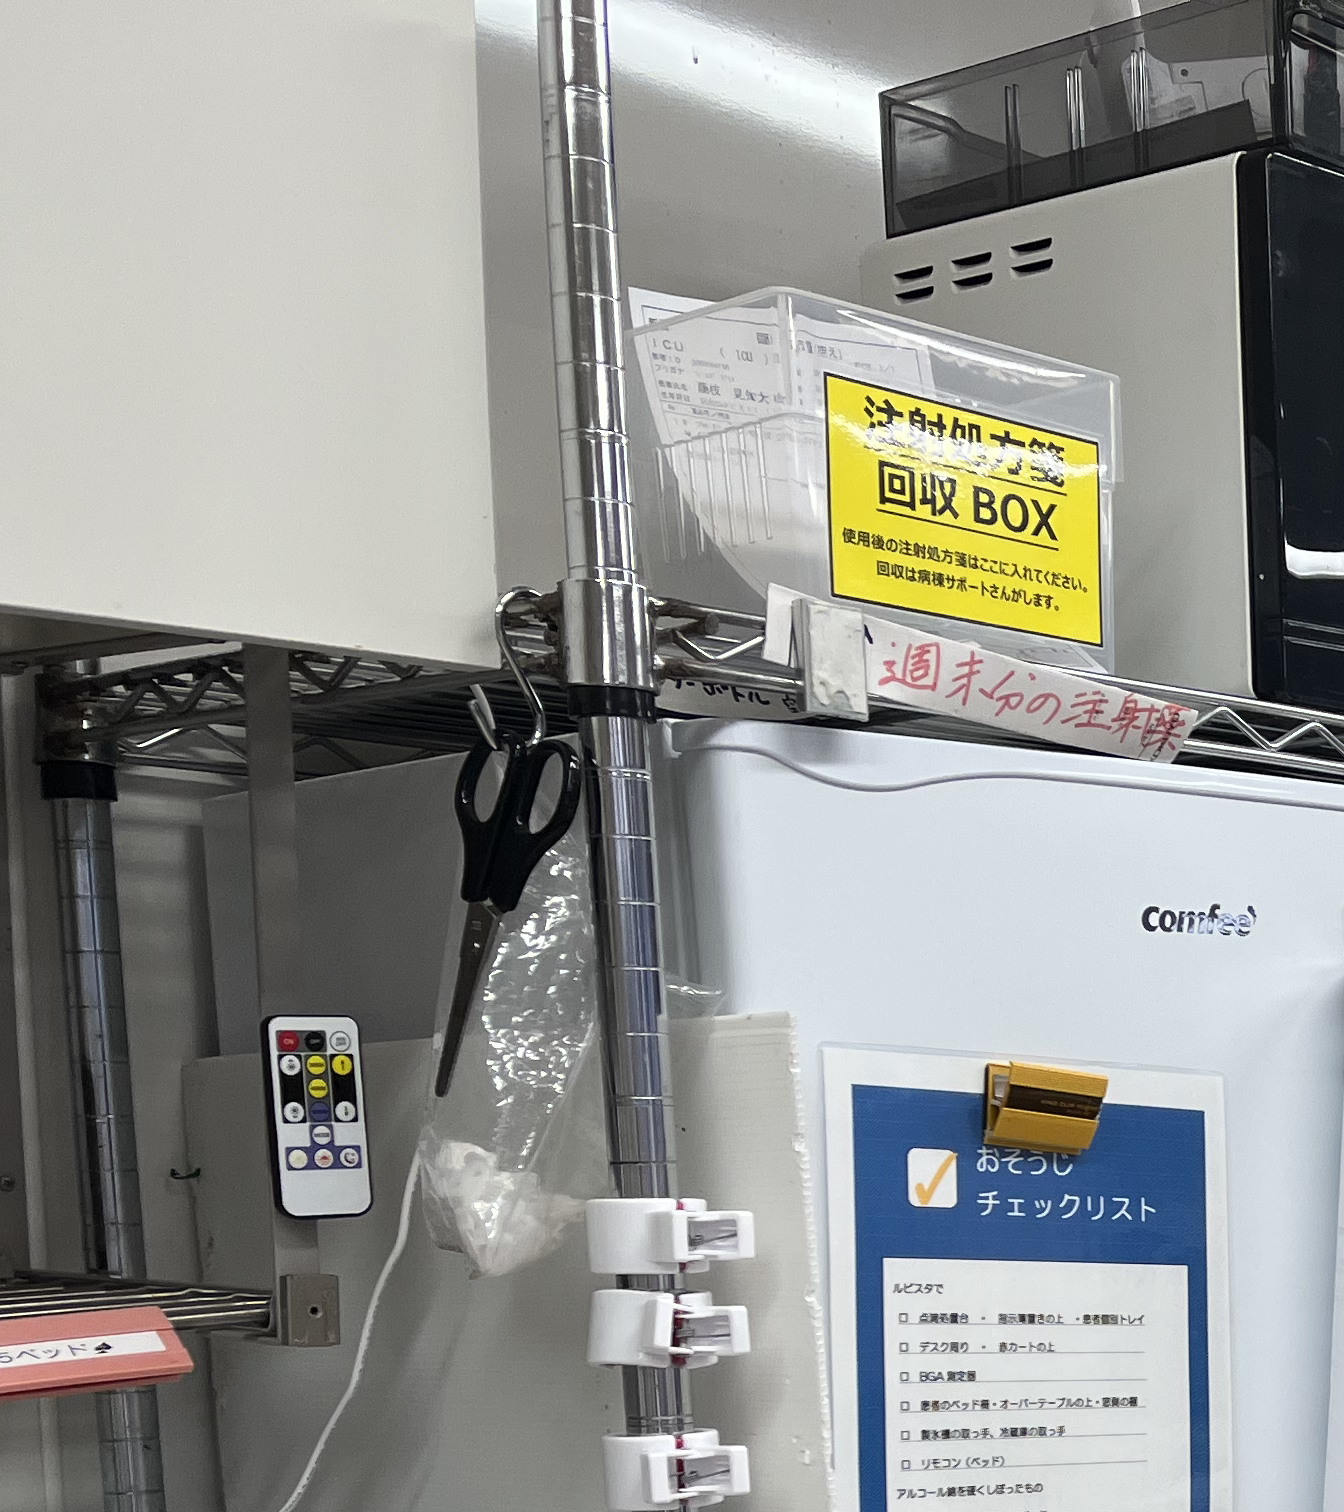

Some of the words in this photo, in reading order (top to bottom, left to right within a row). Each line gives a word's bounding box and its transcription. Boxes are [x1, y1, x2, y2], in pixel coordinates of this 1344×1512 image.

[863, 395, 1065, 488] 注射処方箋
[879, 460, 960, 519] 回収
[972, 485, 1059, 541] BOX
[842, 527, 1088, 593] 使用後の注射処方箋はここに入れてください。
[877, 560, 1060, 611] 回収は病棟サポートさんがします。
[976, 1148, 1074, 1176] おそうじ
[976, 1190, 1157, 1222] チェックリスト
